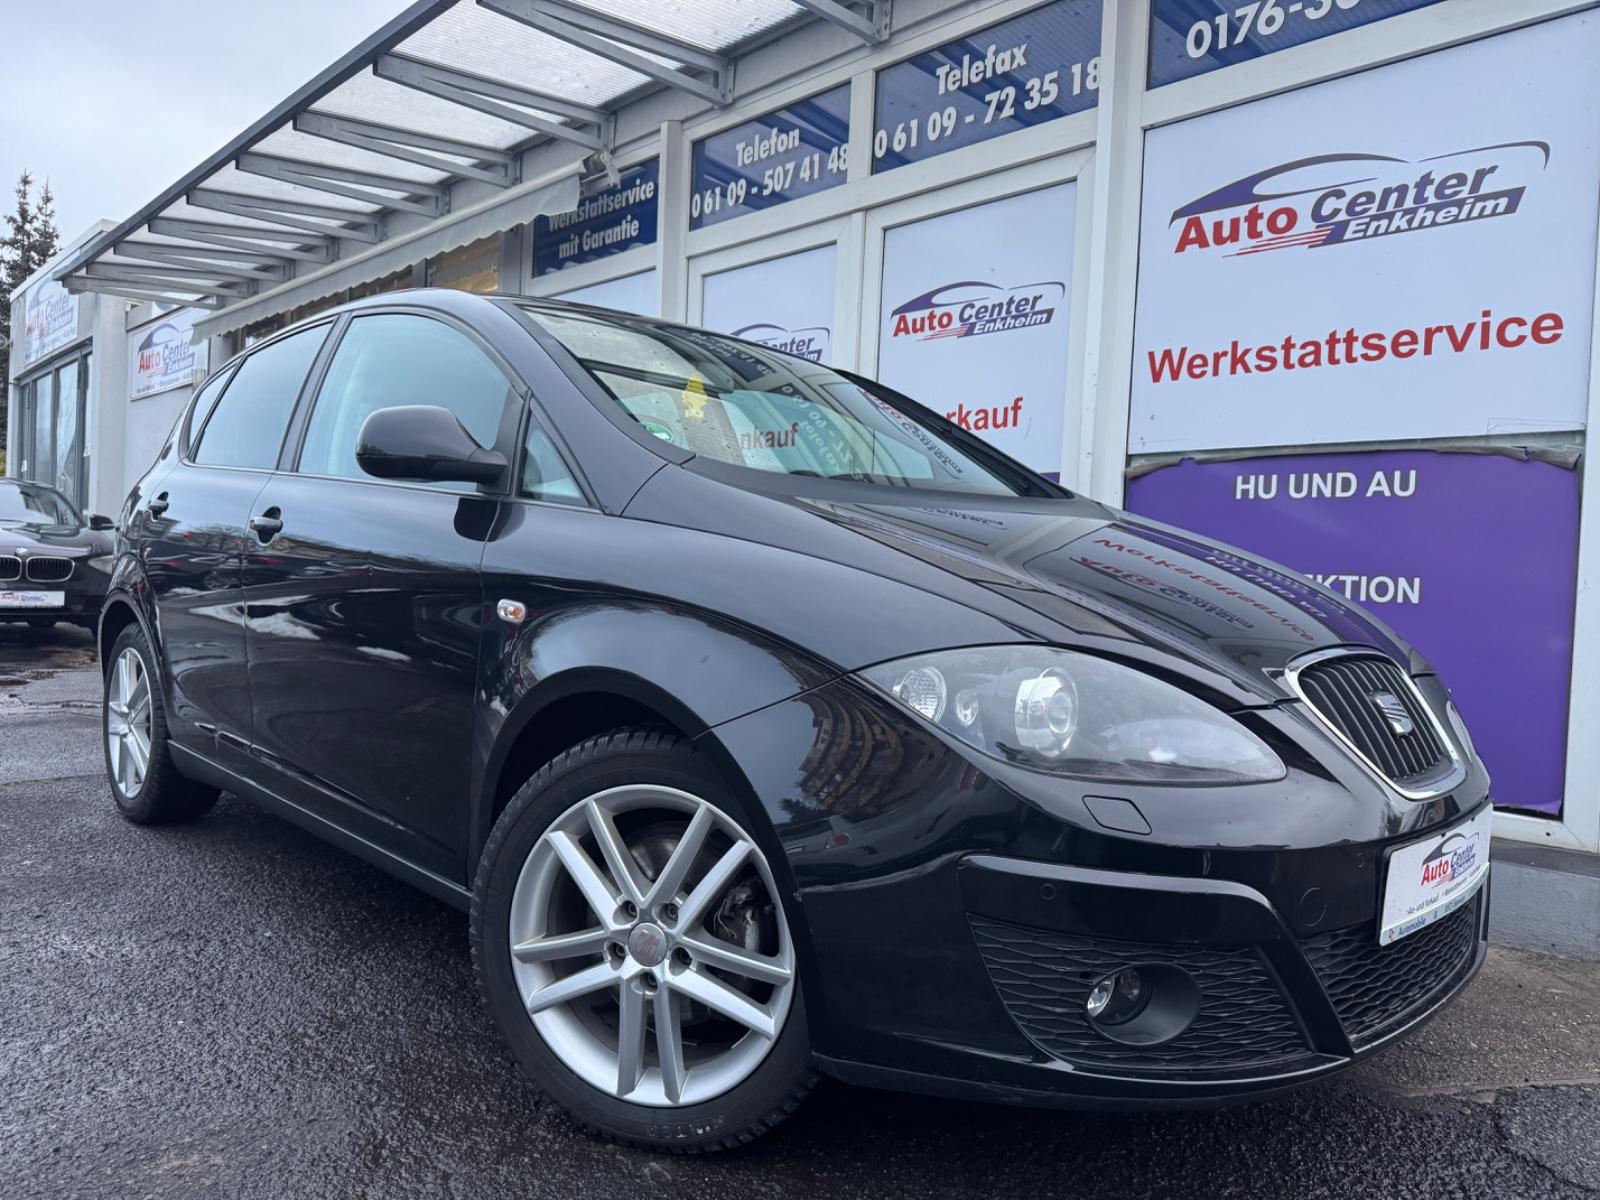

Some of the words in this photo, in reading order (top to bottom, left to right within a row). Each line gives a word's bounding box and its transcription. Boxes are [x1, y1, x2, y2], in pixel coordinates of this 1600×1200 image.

[1185, 0, 1361, 58] 0176-3
[936, 43, 1027, 95] Telefax
[874, 130, 888, 158] 0
[893, 119, 918, 152] 61
[927, 106, 957, 141] 09
[965, 113, 975, 123] -
[984, 86, 1015, 124] 72
[1024, 71, 1058, 110] 35
[1071, 56, 1101, 95] 18
[735, 124, 800, 168] Telefon
[692, 195, 701, 218] 0
[703, 189, 721, 213] 61
[727, 179, 746, 207] 09
[763, 165, 794, 196] 507
[800, 154, 819, 182] 41
[827, 143, 848, 173] 48
[549, 178, 654, 232] Werkstattservice
[1174, 204, 1298, 253] Auto
[1310, 164, 1498, 224] Center
[1343, 194, 1509, 241] Enkheim
[559, 234, 580, 259] mit
[582, 214, 639, 251] Garantie
[893, 308, 953, 337] Auto
[958, 294, 1043, 323] Center
[973, 311, 1047, 334] Enkheim
[139, 351, 160, 373] Auto
[761, 336, 815, 353] nter
[1147, 309, 1564, 383] Werkstattservice
[1236, 474, 1277, 499] HU
[1289, 472, 1357, 499] UND
[1366, 470, 1416, 497] AU
[1303, 574, 1420, 605] KTION
[1421, 858, 1449, 886] Auto
[1451, 842, 1475, 869] Center
